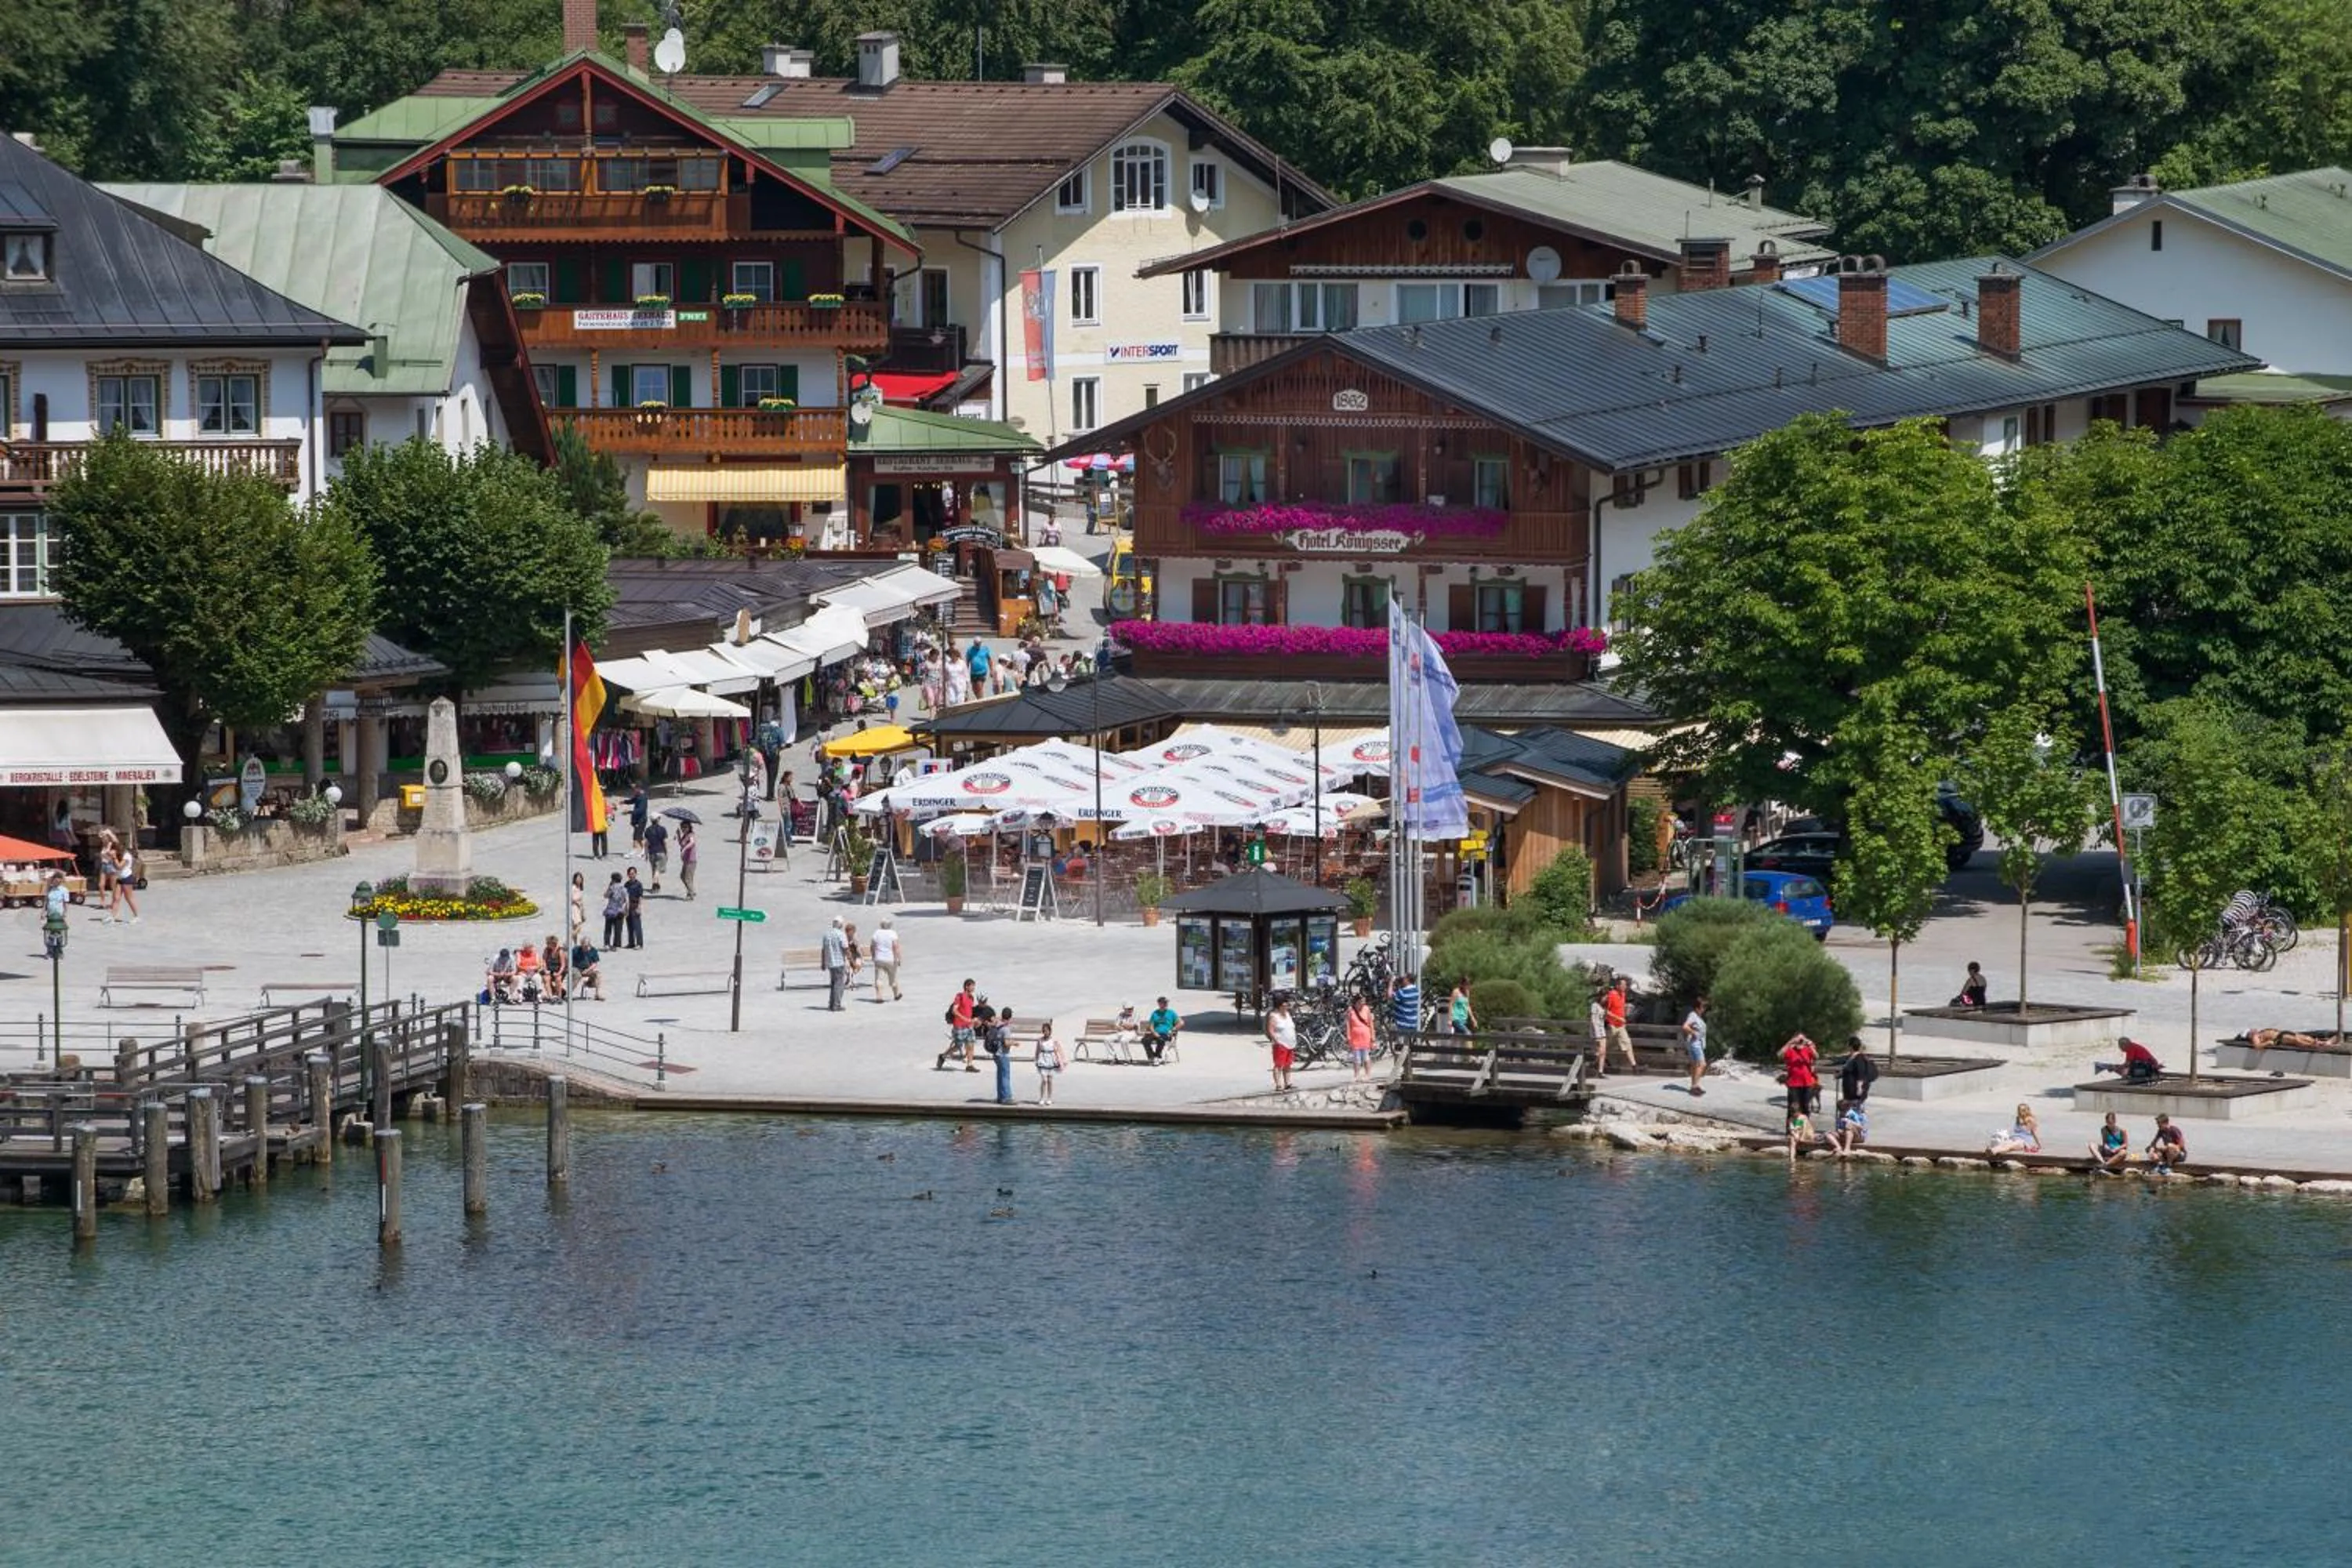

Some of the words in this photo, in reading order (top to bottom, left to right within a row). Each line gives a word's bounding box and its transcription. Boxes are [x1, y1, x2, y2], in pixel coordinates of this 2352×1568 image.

[1120, 344, 1178, 358] INTERSPORT
[1336, 393, 1366, 408] 1862
[1298, 532, 1331, 550] Hotel
[1332, 532, 1401, 552] Königssee
[10, 771, 64, 783] BERGKRISTALLE
[68, 771, 110, 782] EDELSTEINE
[114, 769, 156, 781] MINERALIEN
[912, 797, 956, 807] ERDINGER
[1078, 808, 1123, 818] ERDNGER
